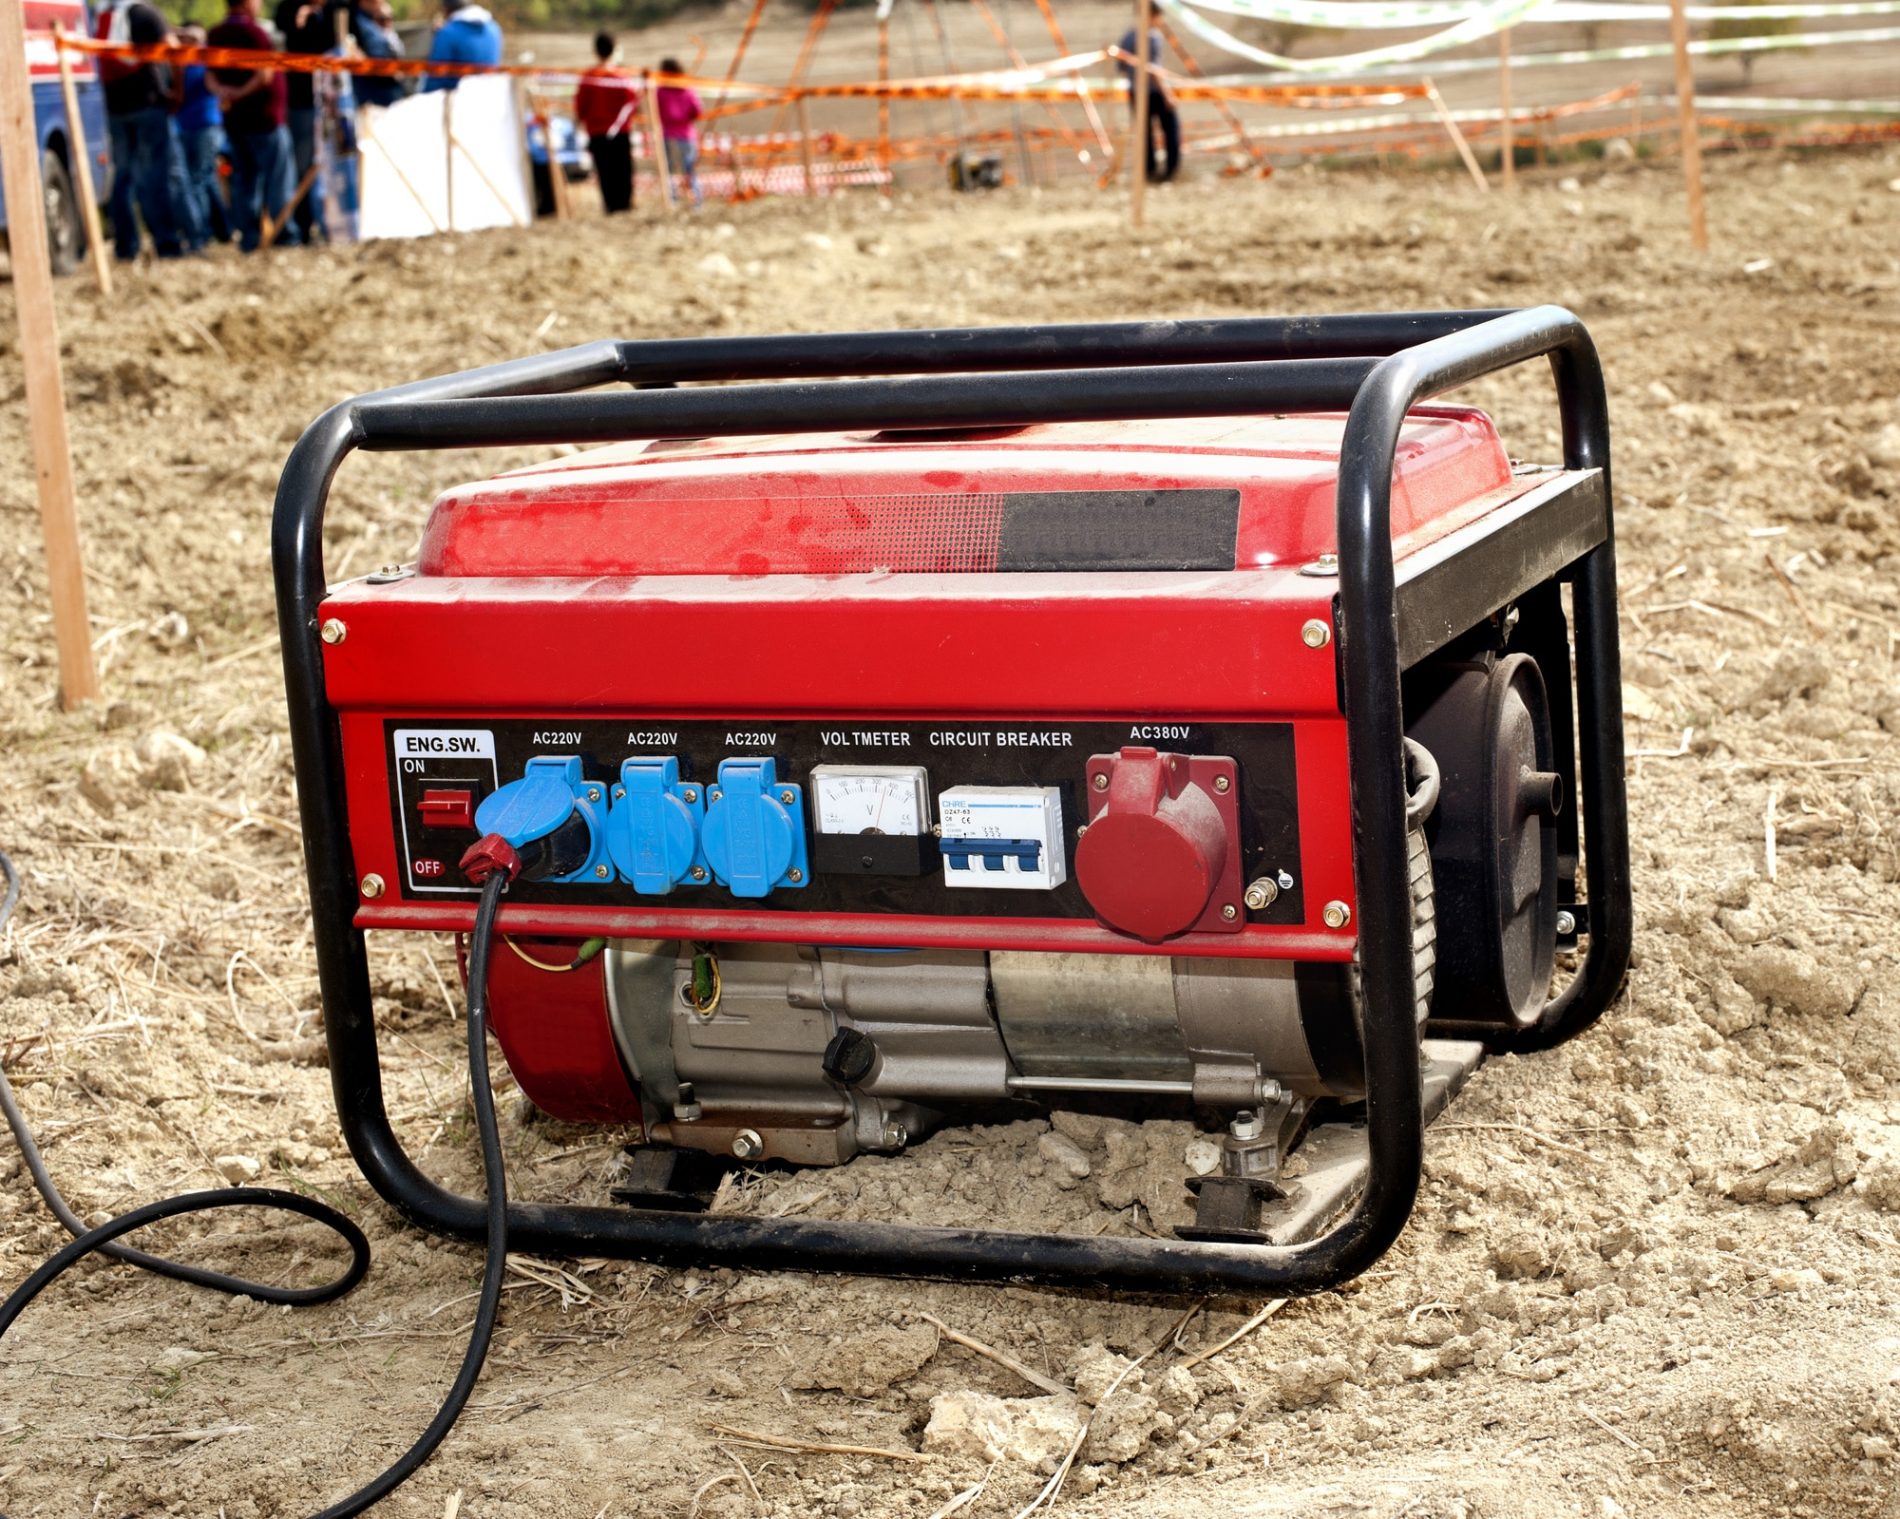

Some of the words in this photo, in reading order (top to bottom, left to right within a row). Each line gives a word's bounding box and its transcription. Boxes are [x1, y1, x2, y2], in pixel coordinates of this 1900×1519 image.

[533, 732, 582, 745] AC220V
[627, 732, 678, 745] AC220V
[725, 733, 777, 746] AC220V
[820, 731, 911, 746] VOLTMETER
[929, 732, 991, 746] CIRCUIT
[996, 732, 1073, 747] BREAKER
[1129, 726, 1190, 740] AC380V
[406, 737, 480, 752] ENG.SW.
[404, 759, 425, 773] ON
[866, 804, 873, 815] V
[415, 861, 440, 874] OFF
